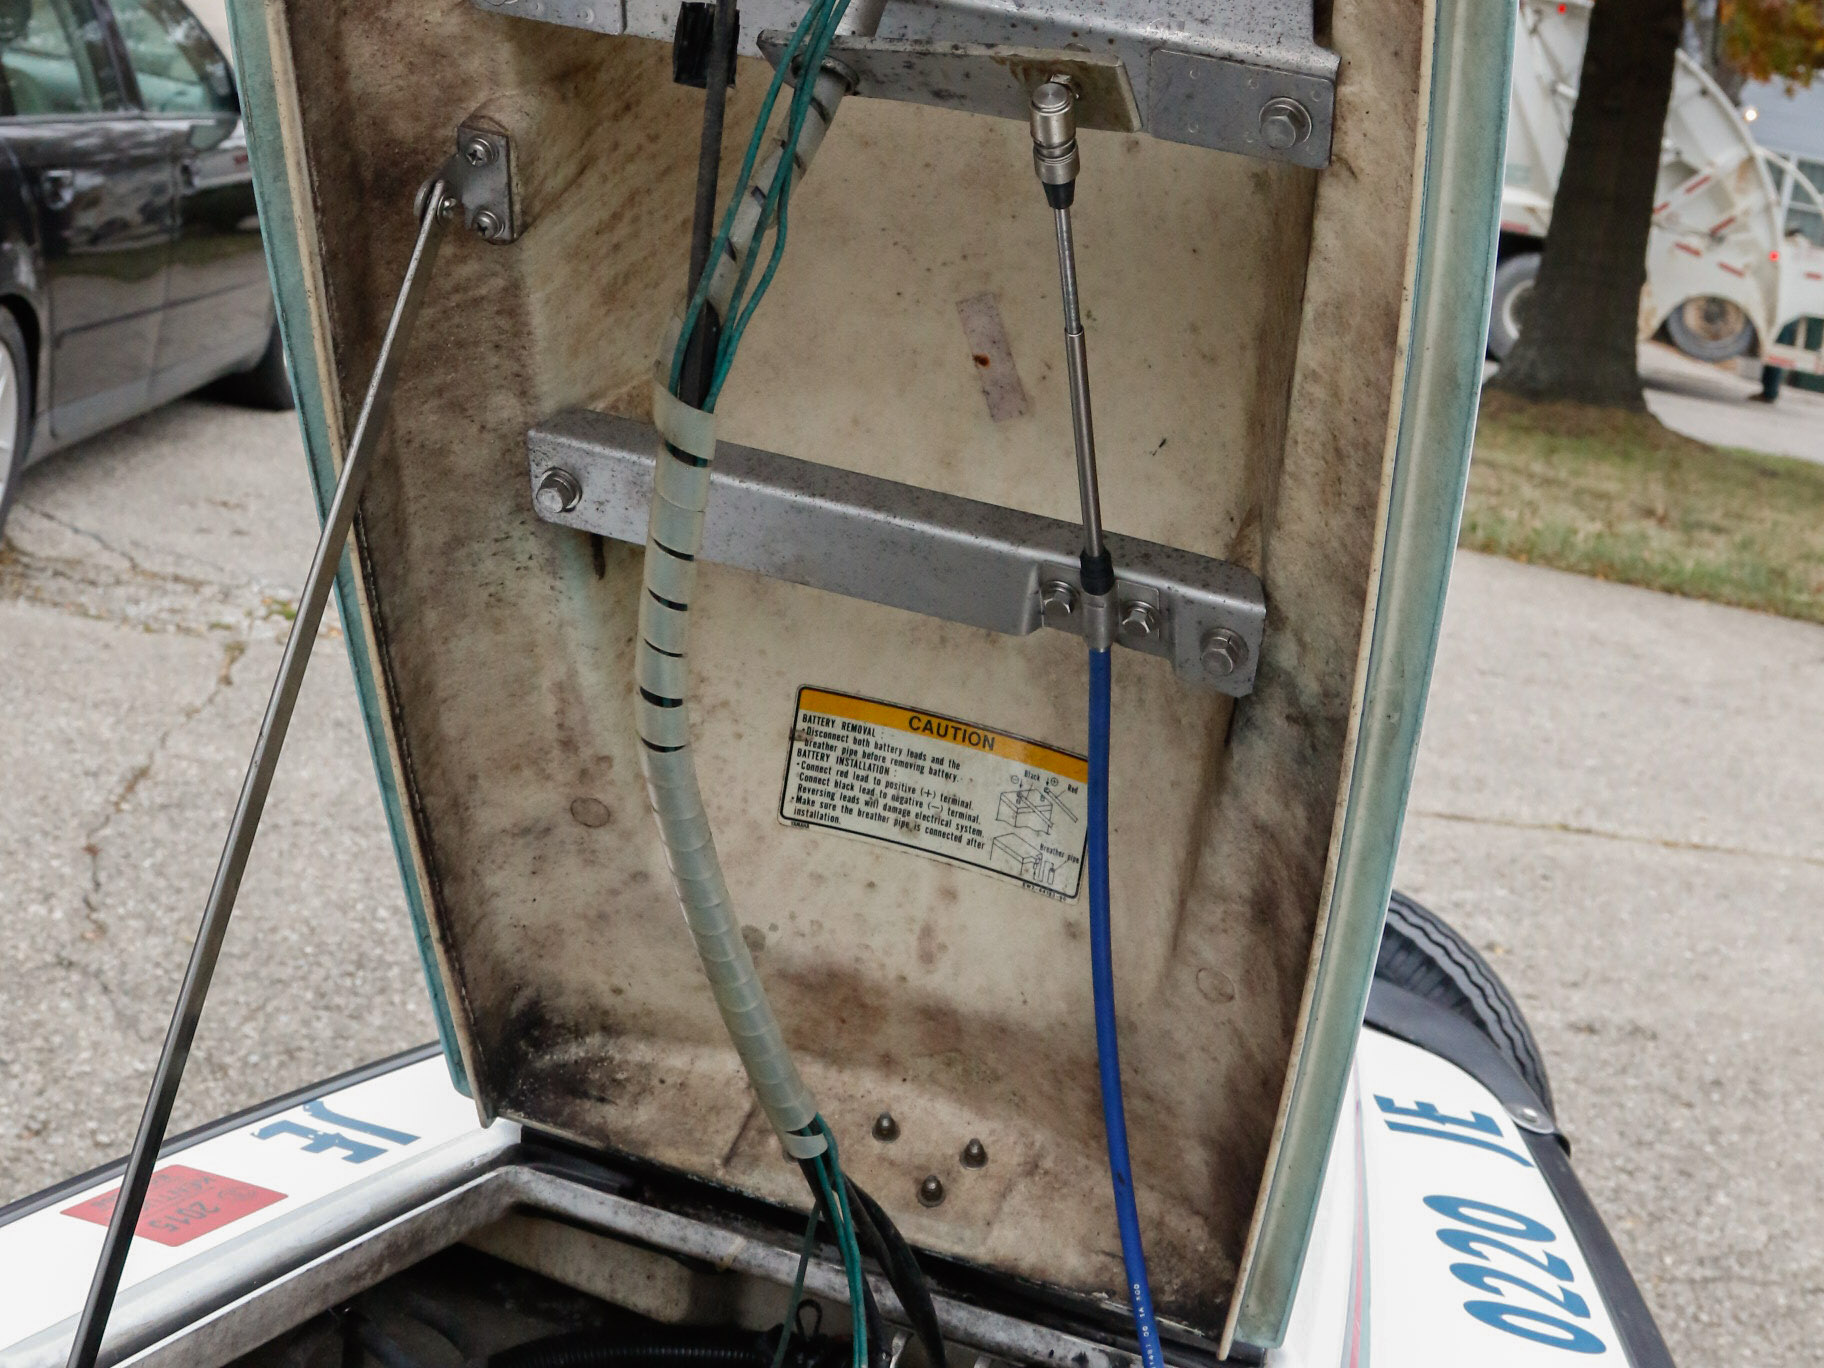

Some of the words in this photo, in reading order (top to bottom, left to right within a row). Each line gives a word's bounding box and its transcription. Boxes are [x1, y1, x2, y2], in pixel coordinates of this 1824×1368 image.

[802, 714, 836, 728] BATTERY
[841, 721, 876, 738] REMOVAL
[908, 715, 995, 751] CAUTION
[796, 748, 831, 763] BATTERY
[835, 756, 890, 776] INSTALLATION
[804, 738, 838, 753] breather
[841, 746, 858, 758] pipe
[861, 749, 887, 763] before
[890, 757, 925, 775] removing
[806, 726, 849, 744] Disconnect
[852, 736, 870, 748] both
[874, 741, 903, 757] battery
[907, 748, 927, 762] leads
[930, 755, 945, 766] and
[948, 759, 961, 770] the
[799, 772, 830, 787] Connect
[834, 779, 855, 792] black
[858, 784, 875, 797] lead
[879, 790, 888, 799] to
[891, 793, 924, 809] negative
[801, 760, 832, 776] Connect
[835, 768, 849, 779] red
[852, 771, 869, 783] lead
[873, 776, 881, 786] to
[885, 780, 916, 795] positive
[1024, 769, 1040, 782] Black
[1067, 783, 1079, 794] Red
[795, 794, 816, 807] Make
[819, 801, 837, 812] sure
[840, 805, 853, 815] the
[857, 808, 890, 824] breather
[893, 817, 910, 830] pipe
[913, 821, 921, 832] is
[924, 826, 963, 844] connected
[966, 837, 986, 850] after
[797, 783, 836, 802] Reversing
[839, 792, 860, 805] leads
[864, 799, 879, 810] will
[883, 802, 911, 818] damage
[914, 812, 952, 828] electrical
[1039, 842, 1065, 858] Breather
[1067, 854, 1080, 864] pipe
[250, 1100, 421, 1164] JE
[1373, 1094, 1535, 1167] JE
[1422, 1195, 1607, 1354] 0220
